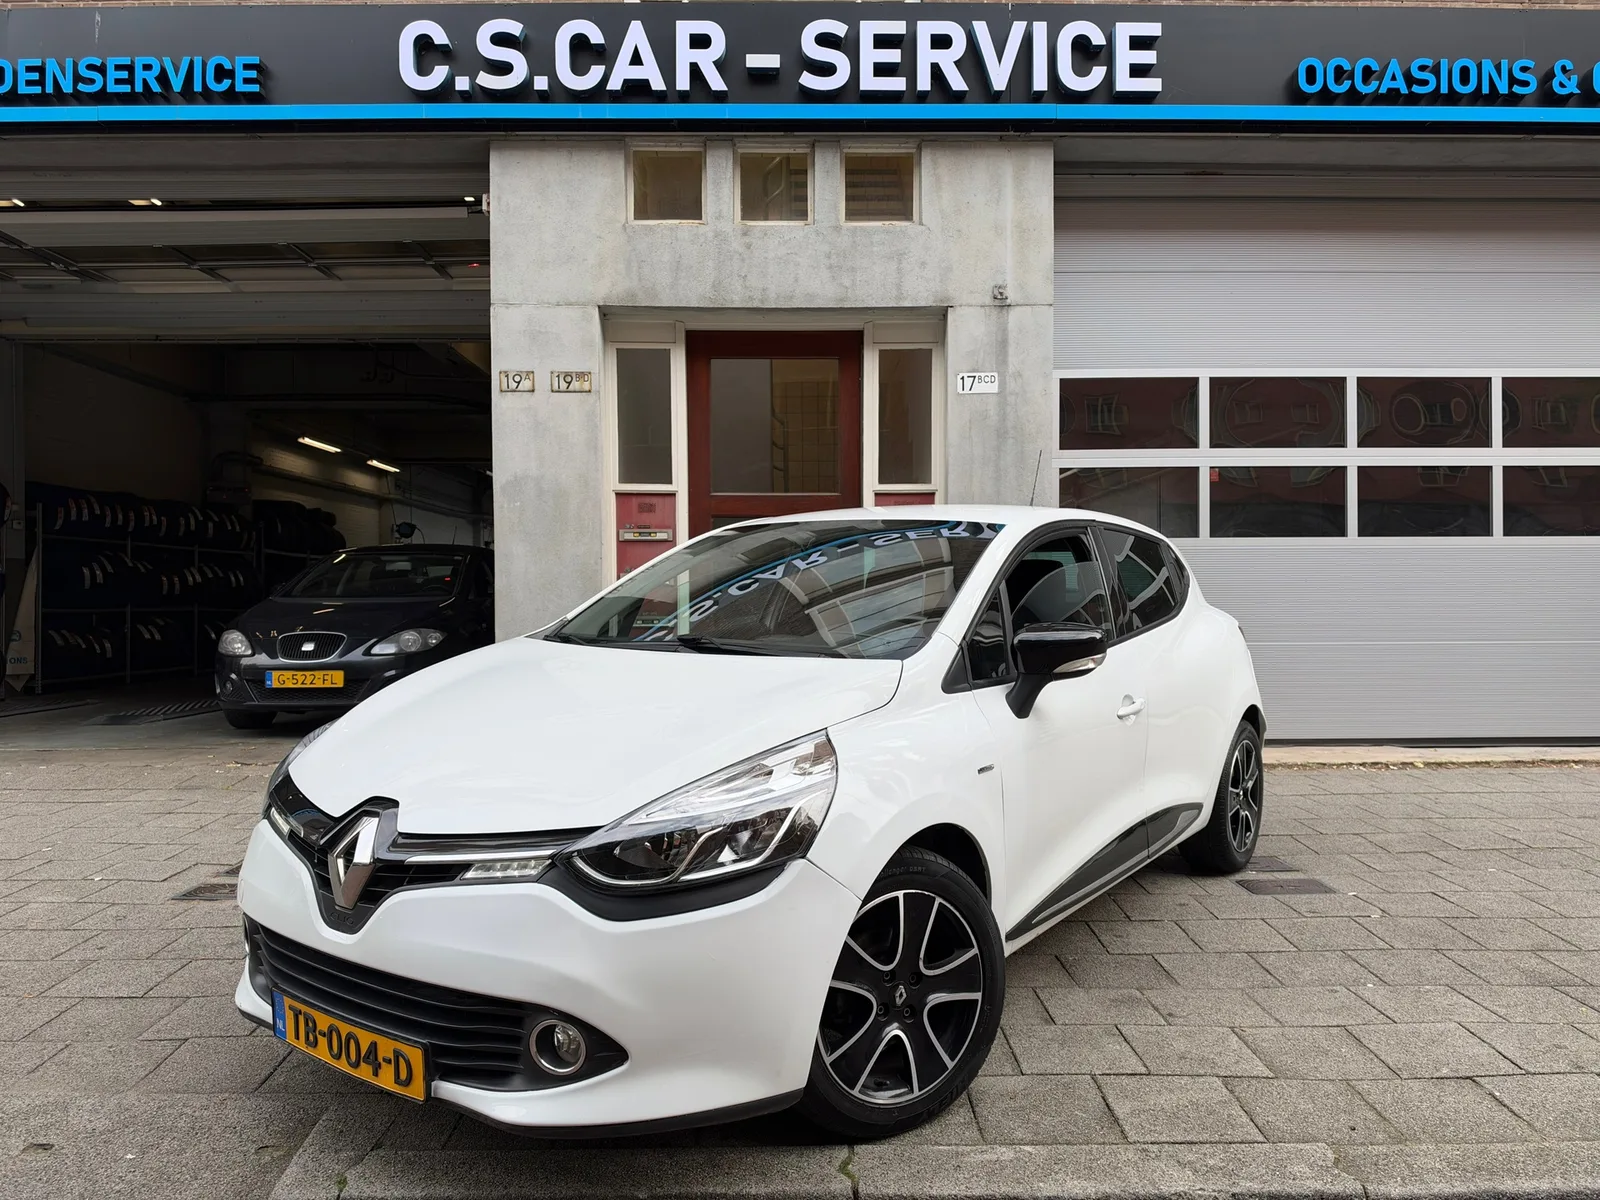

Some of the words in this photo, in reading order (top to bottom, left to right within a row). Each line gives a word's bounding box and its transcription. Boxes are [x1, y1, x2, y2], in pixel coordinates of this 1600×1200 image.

[398, 18, 729, 91] C.S.CAR
[798, 18, 1162, 92] SERVICE
[1297, 57, 1538, 94] OCCASIONS
[1552, 59, 1581, 95] &
[277, 673, 338, 686] G-522-FL
[288, 1004, 413, 1087] TB-004-D
